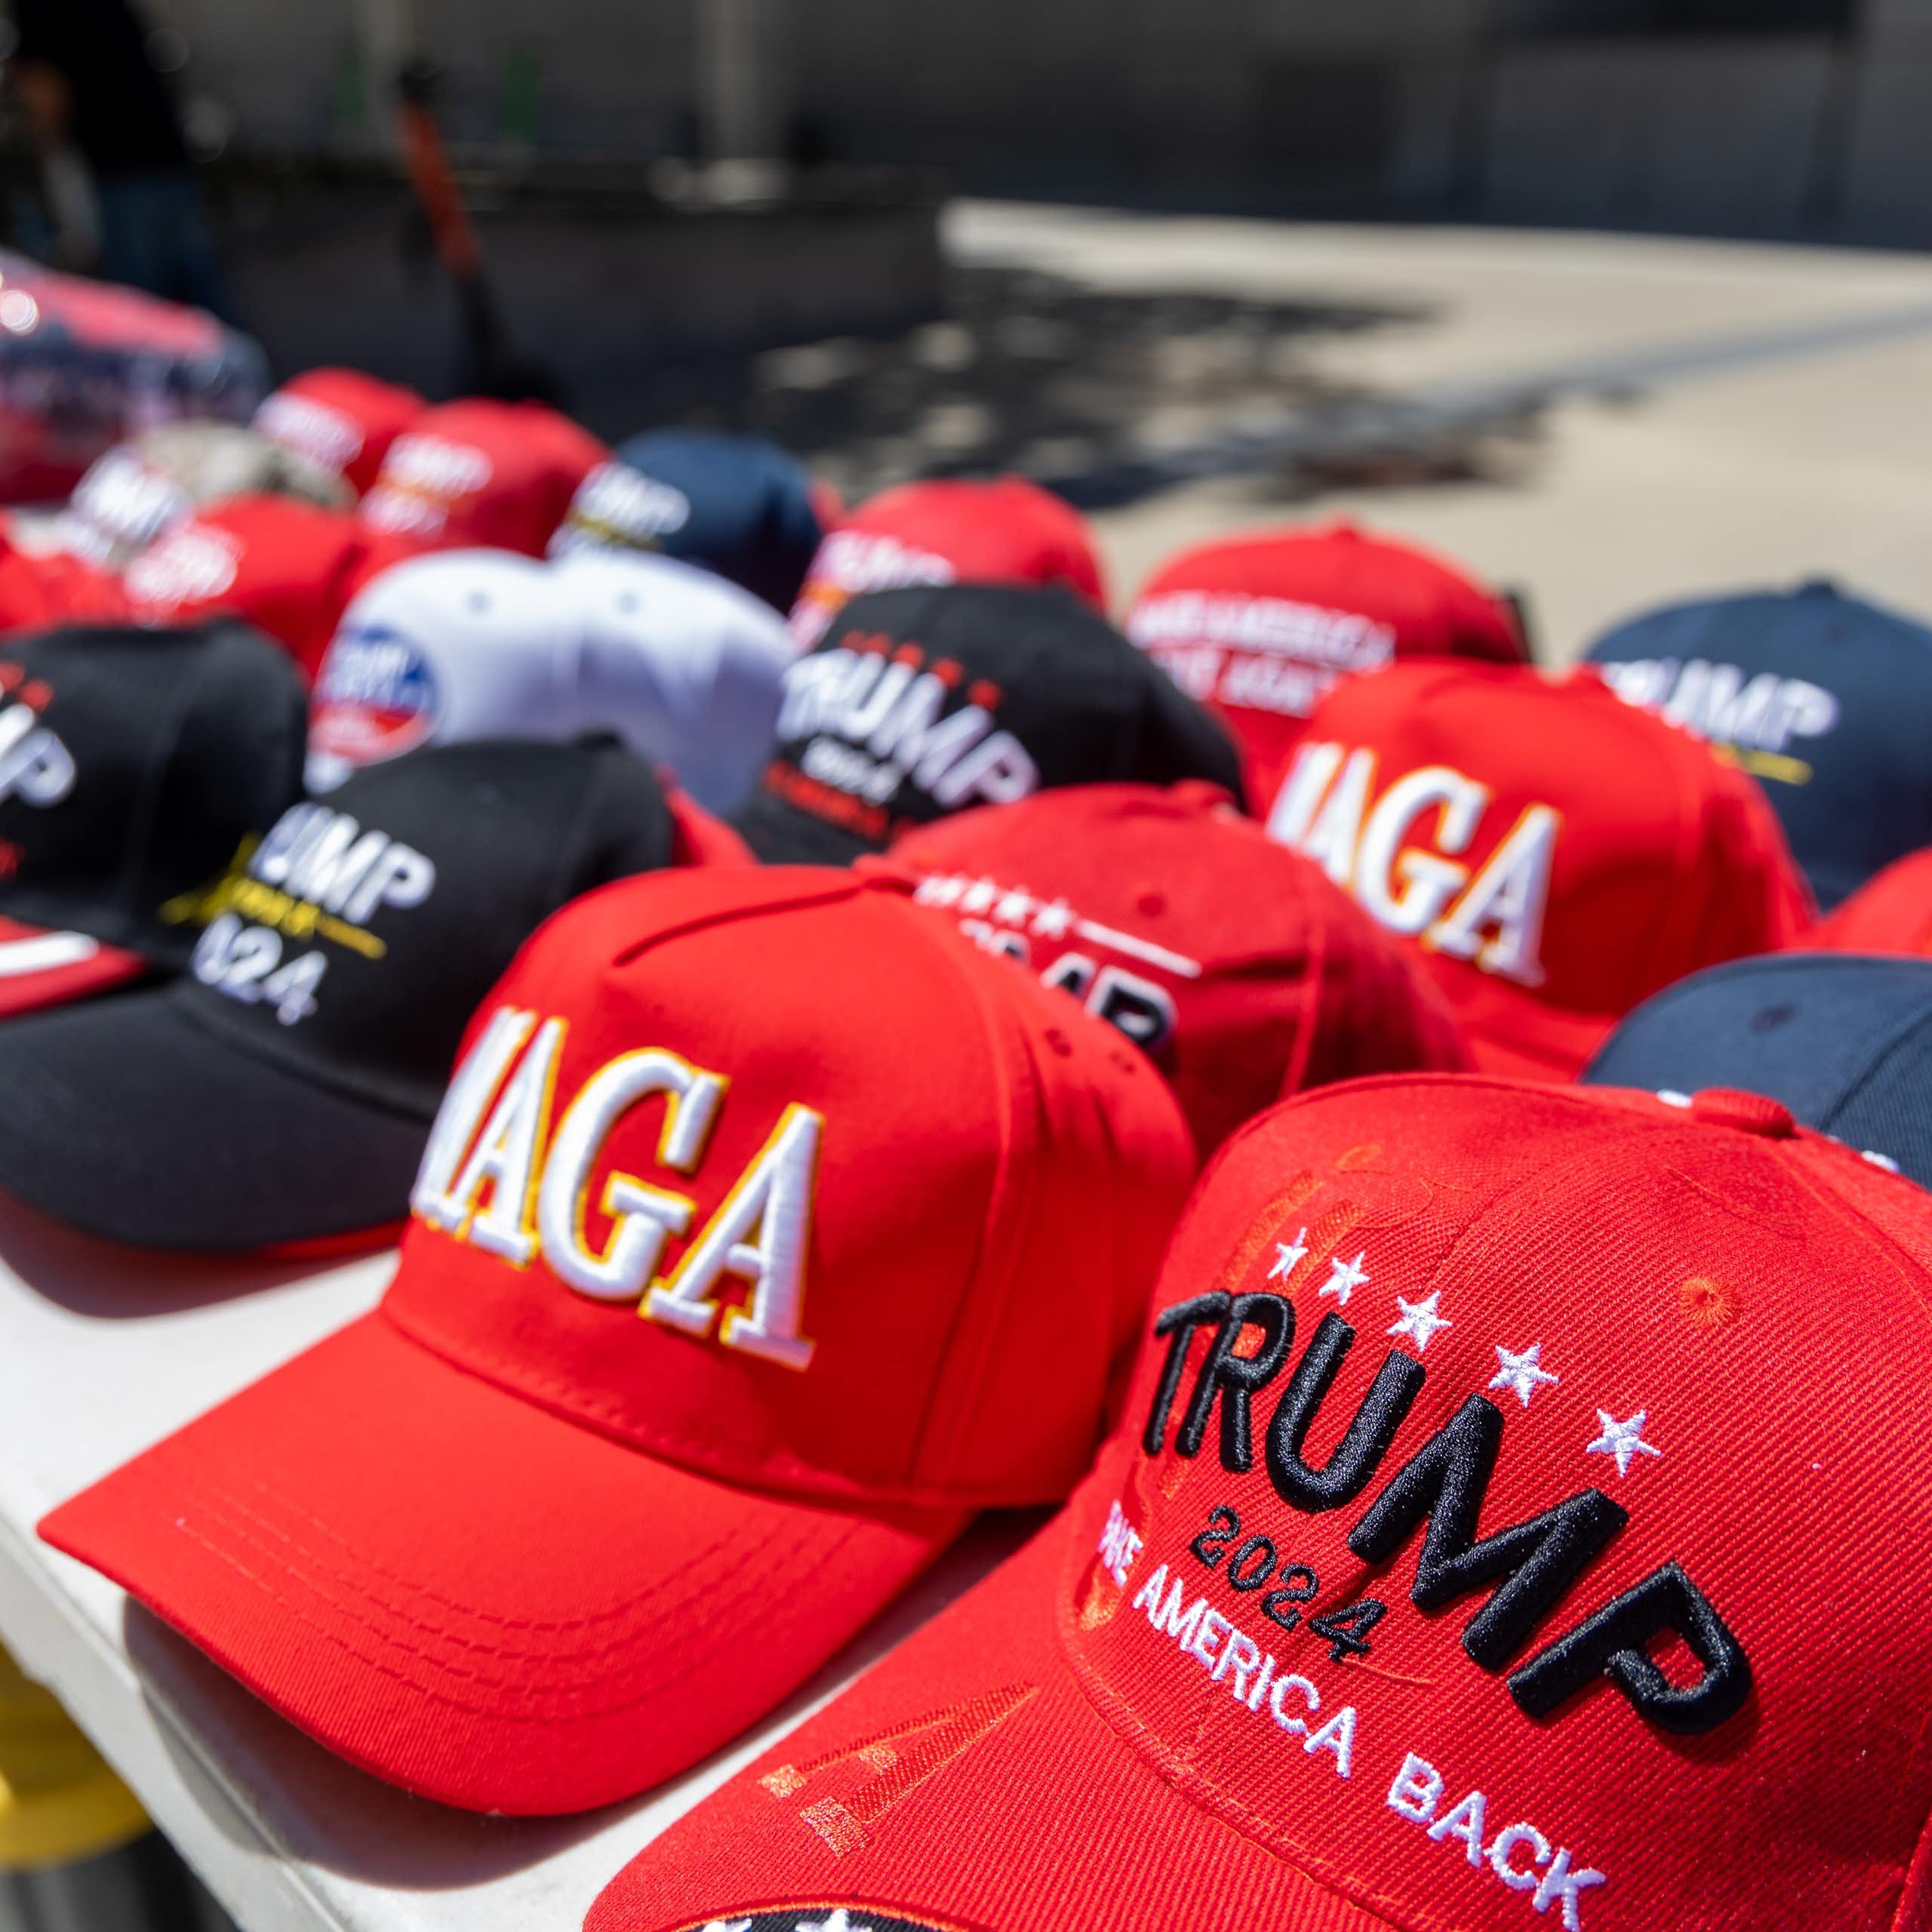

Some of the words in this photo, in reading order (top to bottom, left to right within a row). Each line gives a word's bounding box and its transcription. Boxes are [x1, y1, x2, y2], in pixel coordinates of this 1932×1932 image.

[1143, 1290, 1752, 1734] TRUMP
[1189, 1504, 1387, 1662] 2024
[1134, 1563, 1357, 1780] AMERICA
[1386, 1752, 1605, 1932] BACK
